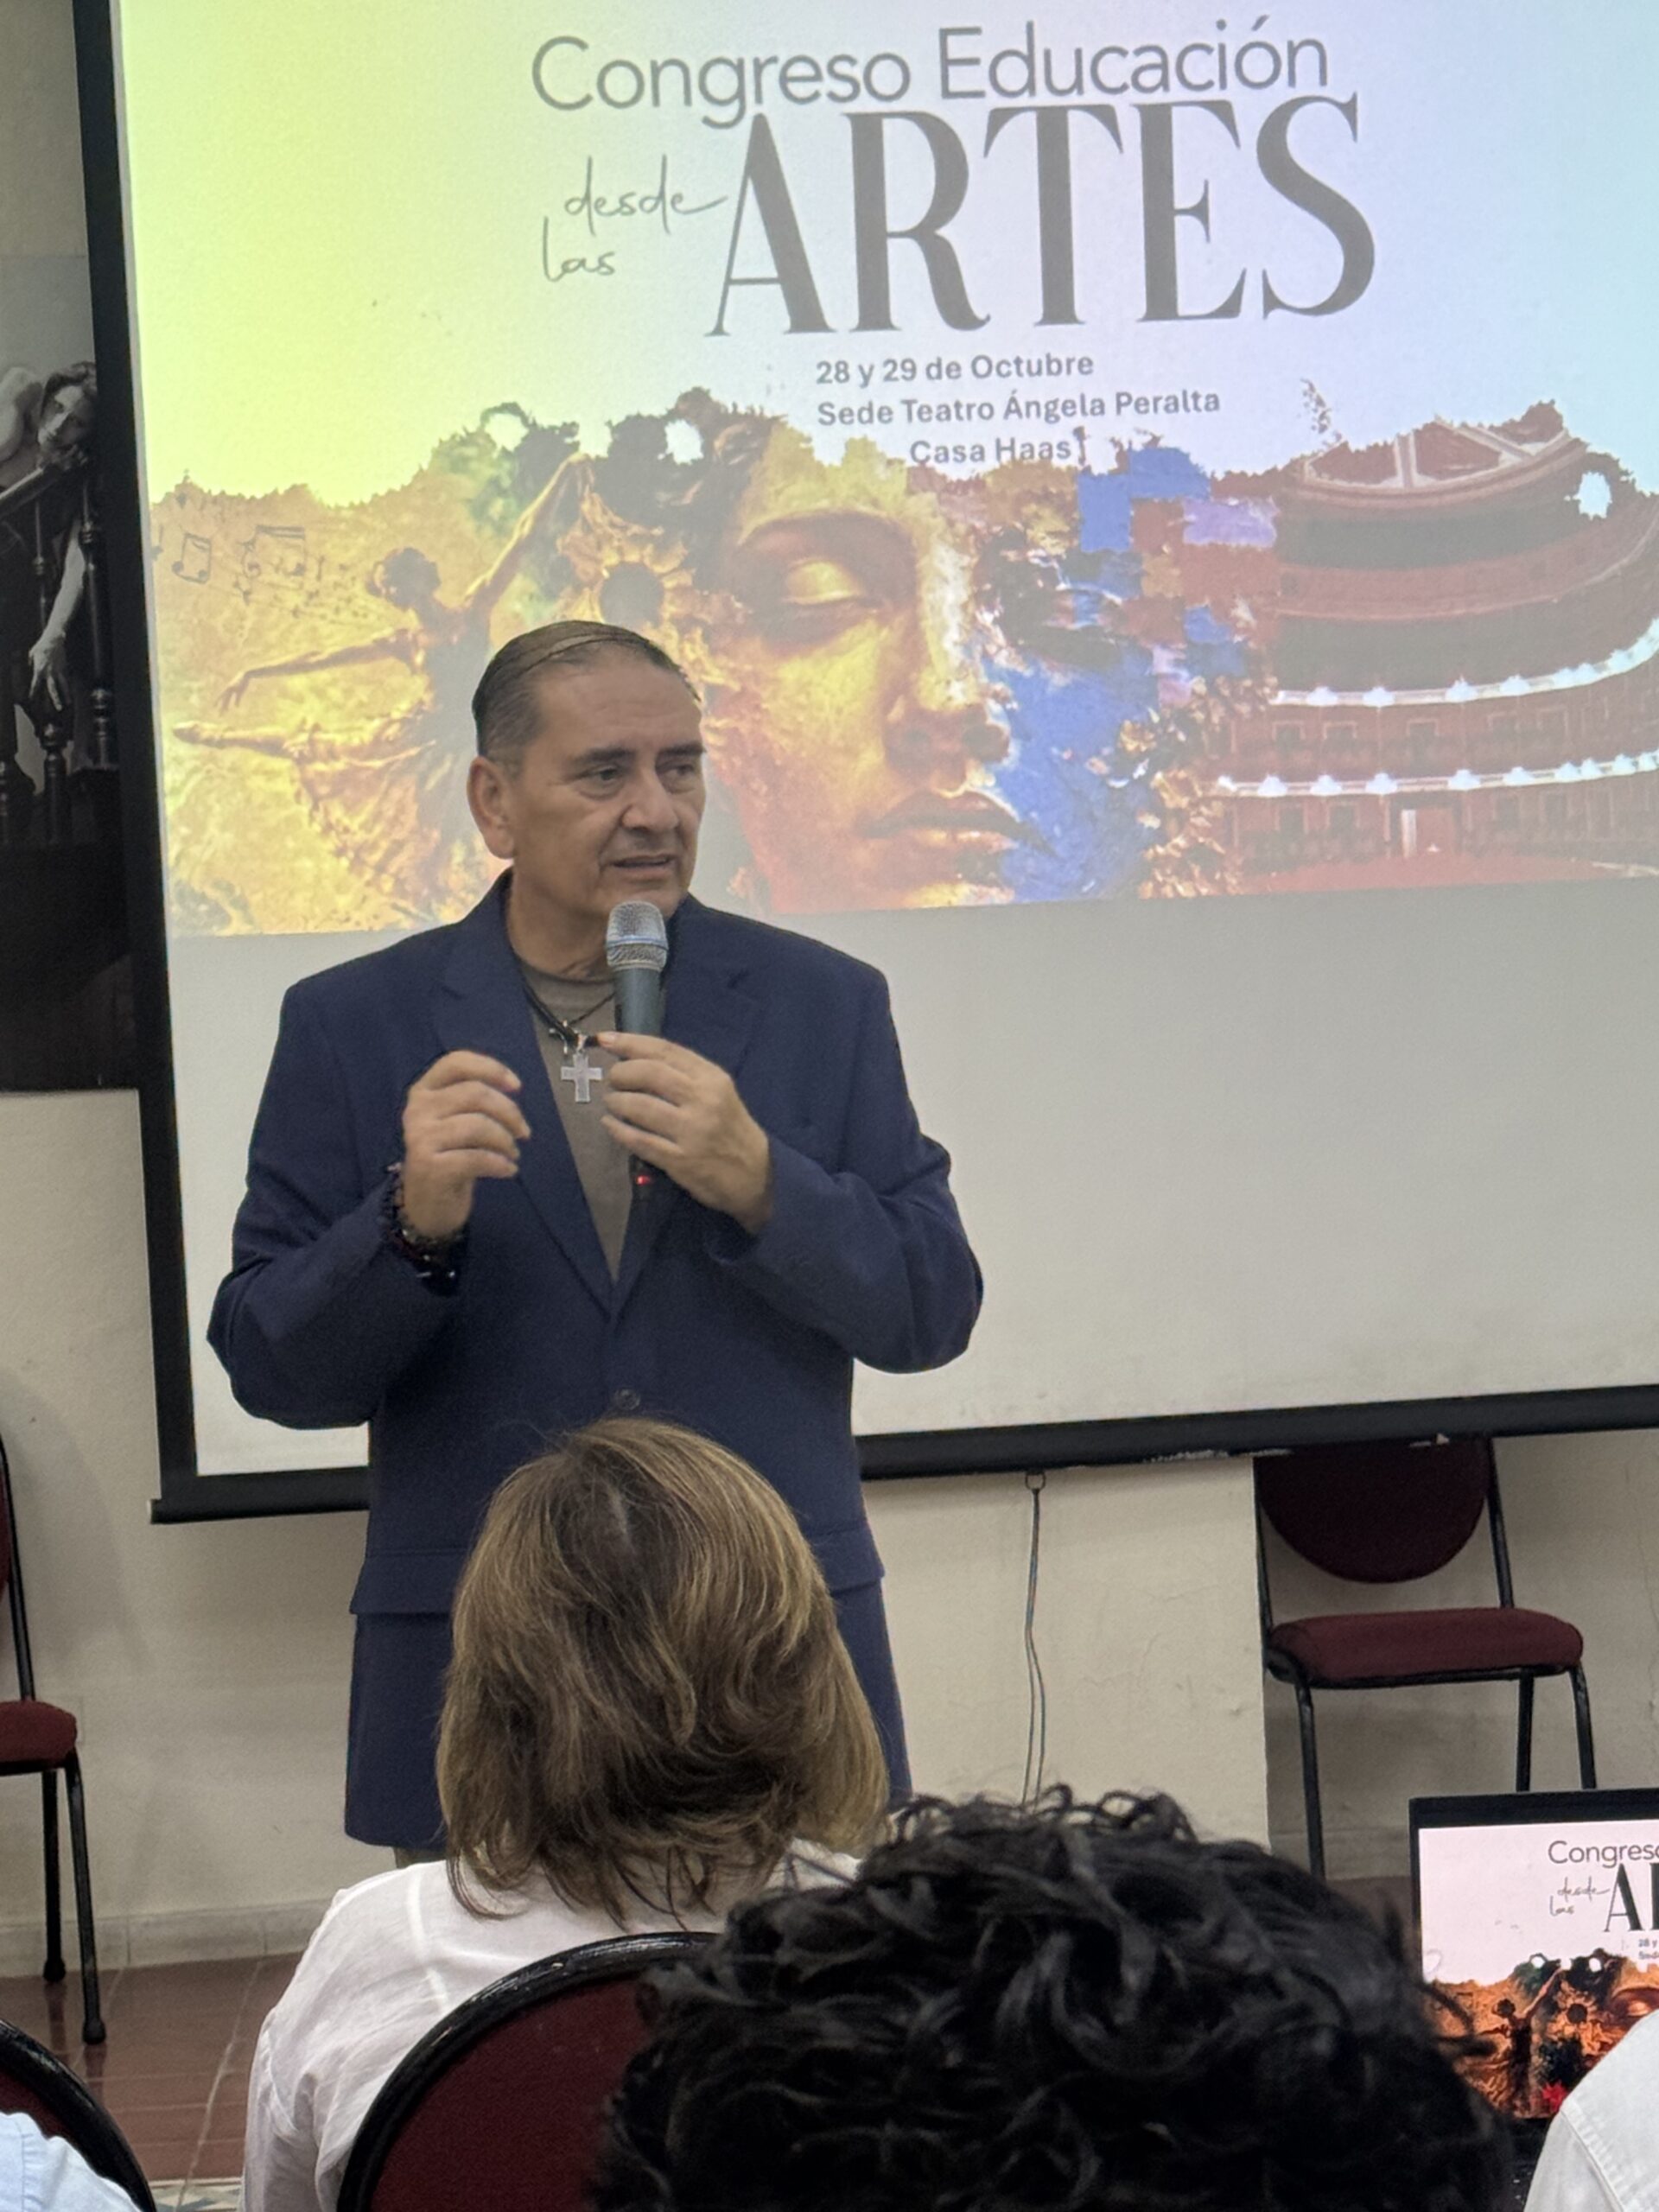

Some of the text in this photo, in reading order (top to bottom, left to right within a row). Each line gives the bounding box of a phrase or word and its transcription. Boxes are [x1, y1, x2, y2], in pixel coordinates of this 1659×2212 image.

[531, 13, 1328, 130] Congreso Educación
[564, 153, 729, 238] desde
[703, 91, 1376, 337] ARTES
[542, 215, 616, 283] las
[816, 352, 1095, 390] 28 y 29 de Octubre
[817, 388, 1221, 427] Sede Teatro Ángela Peralta
[909, 436, 1072, 465] Casa Haas
[1548, 1840, 1659, 1869] Congres
